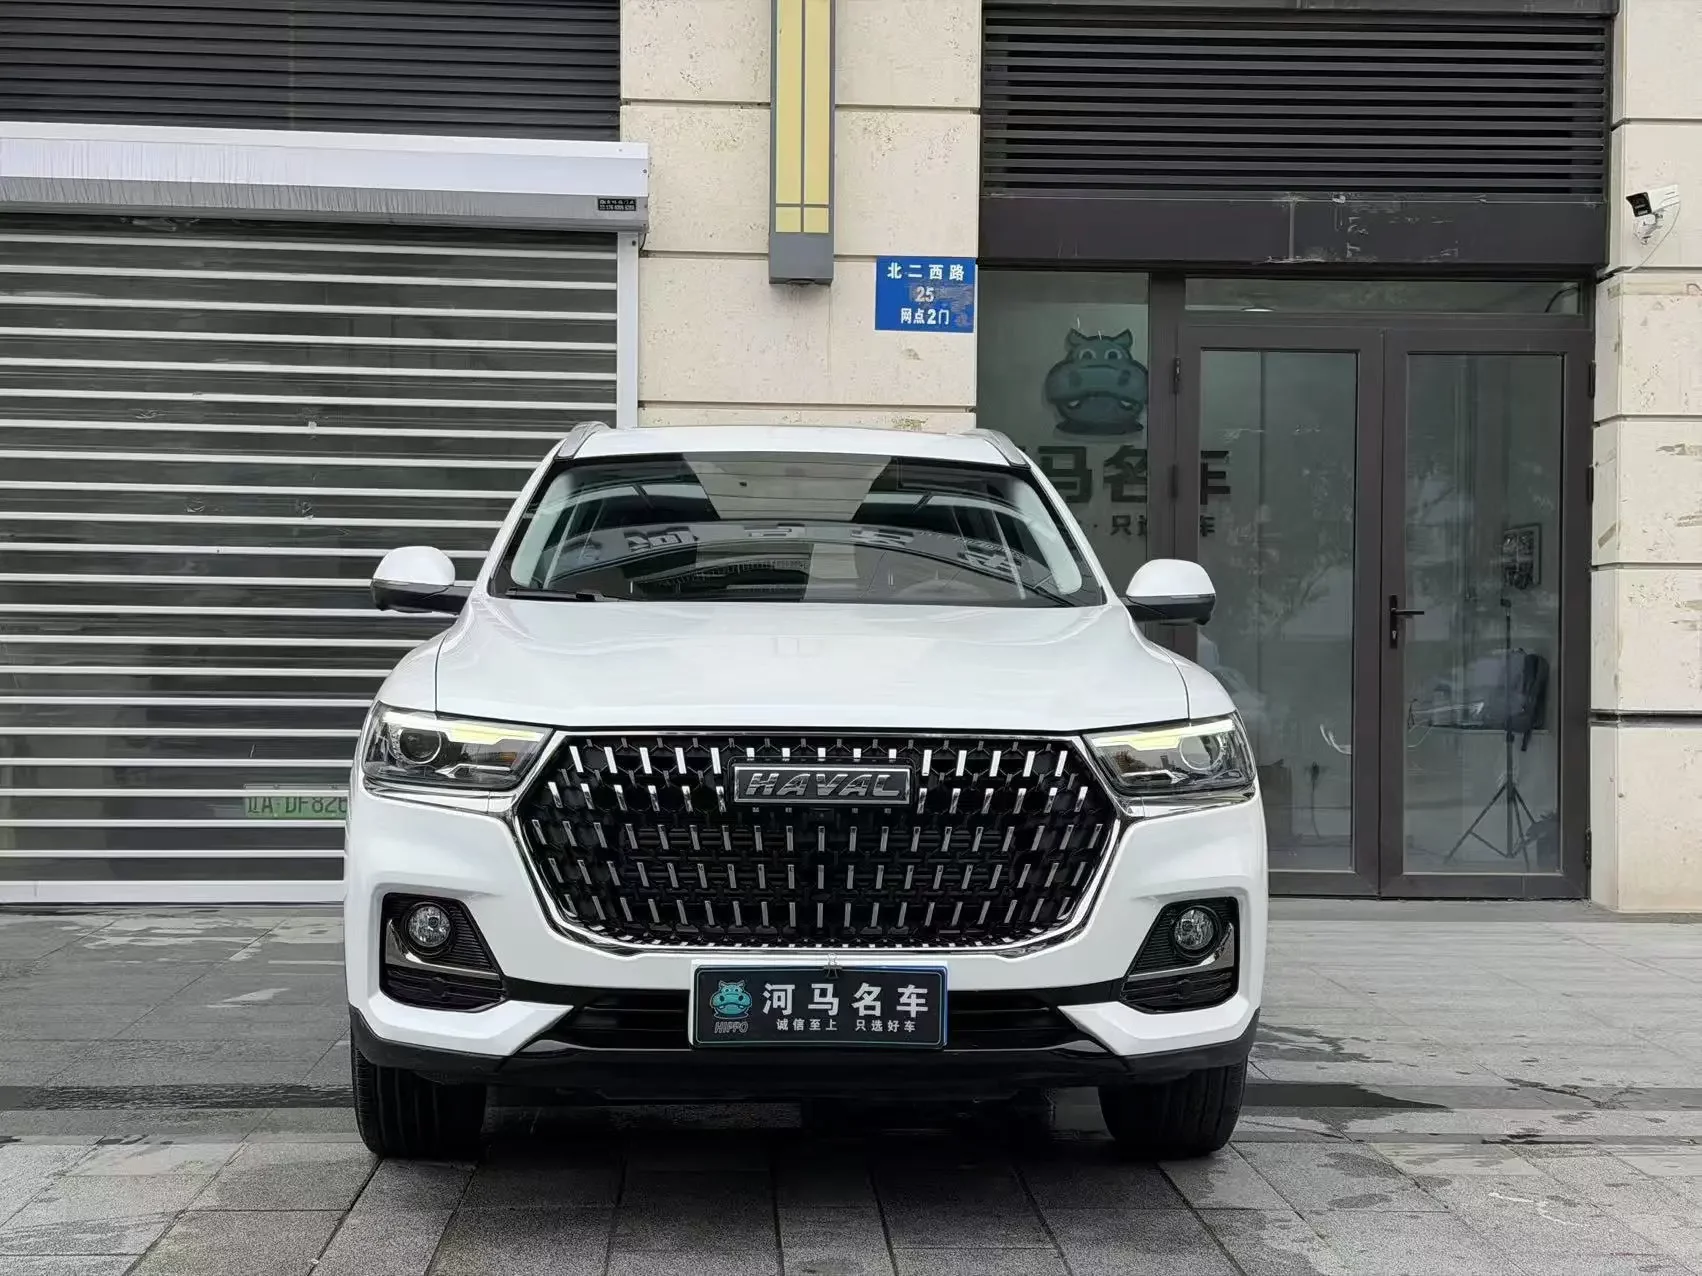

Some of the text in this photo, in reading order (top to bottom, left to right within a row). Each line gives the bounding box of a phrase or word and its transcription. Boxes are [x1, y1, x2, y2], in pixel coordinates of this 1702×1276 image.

[887, 261, 965, 281] 北二西路
[914, 286, 936, 303] 25
[900, 307, 950, 325] 网点2门
[745, 772, 900, 797] HAVAL
[762, 982, 929, 1018] 河马名车
[714, 1021, 749, 1034] HIPPO
[776, 1018, 916, 1033] 诚信至上 只选好车
